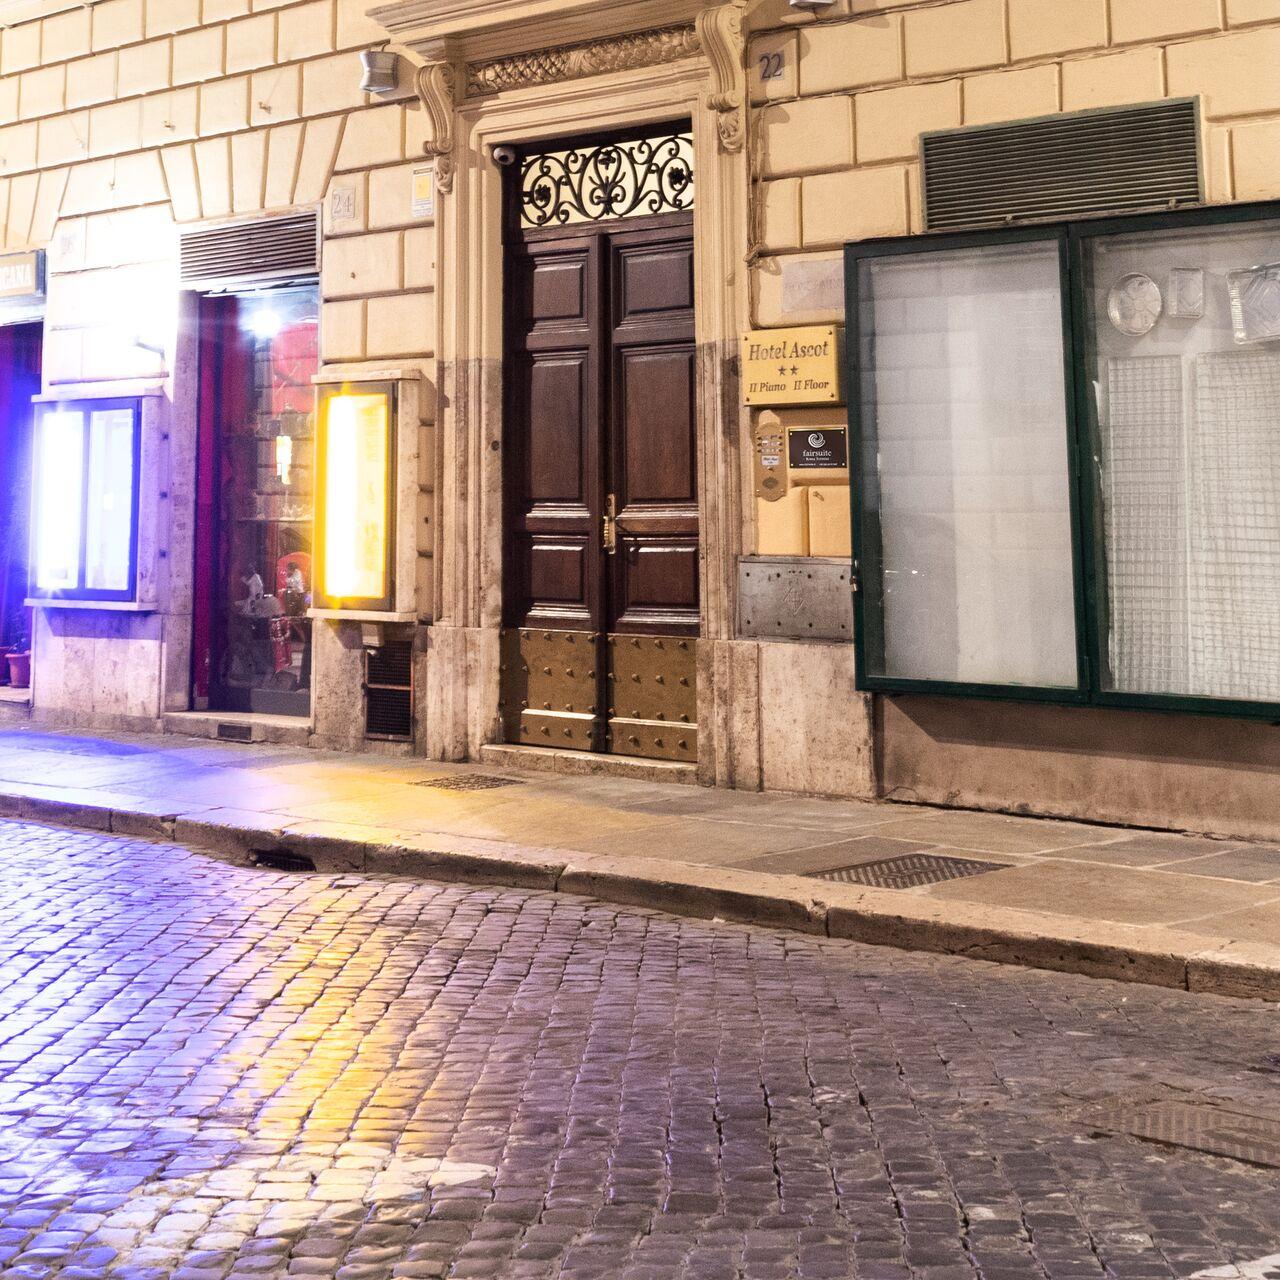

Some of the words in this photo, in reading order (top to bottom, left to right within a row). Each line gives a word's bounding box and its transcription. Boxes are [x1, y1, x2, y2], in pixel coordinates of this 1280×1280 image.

[760, 53, 782, 80] 22
[332, 193, 352, 214] 24
[748, 341, 786, 360] Hotel
[789, 341, 829, 358] Ascot
[749, 382, 758, 393] II
[759, 381, 786, 393] Piano
[793, 380, 802, 391] II
[804, 379, 829, 390] Floor
